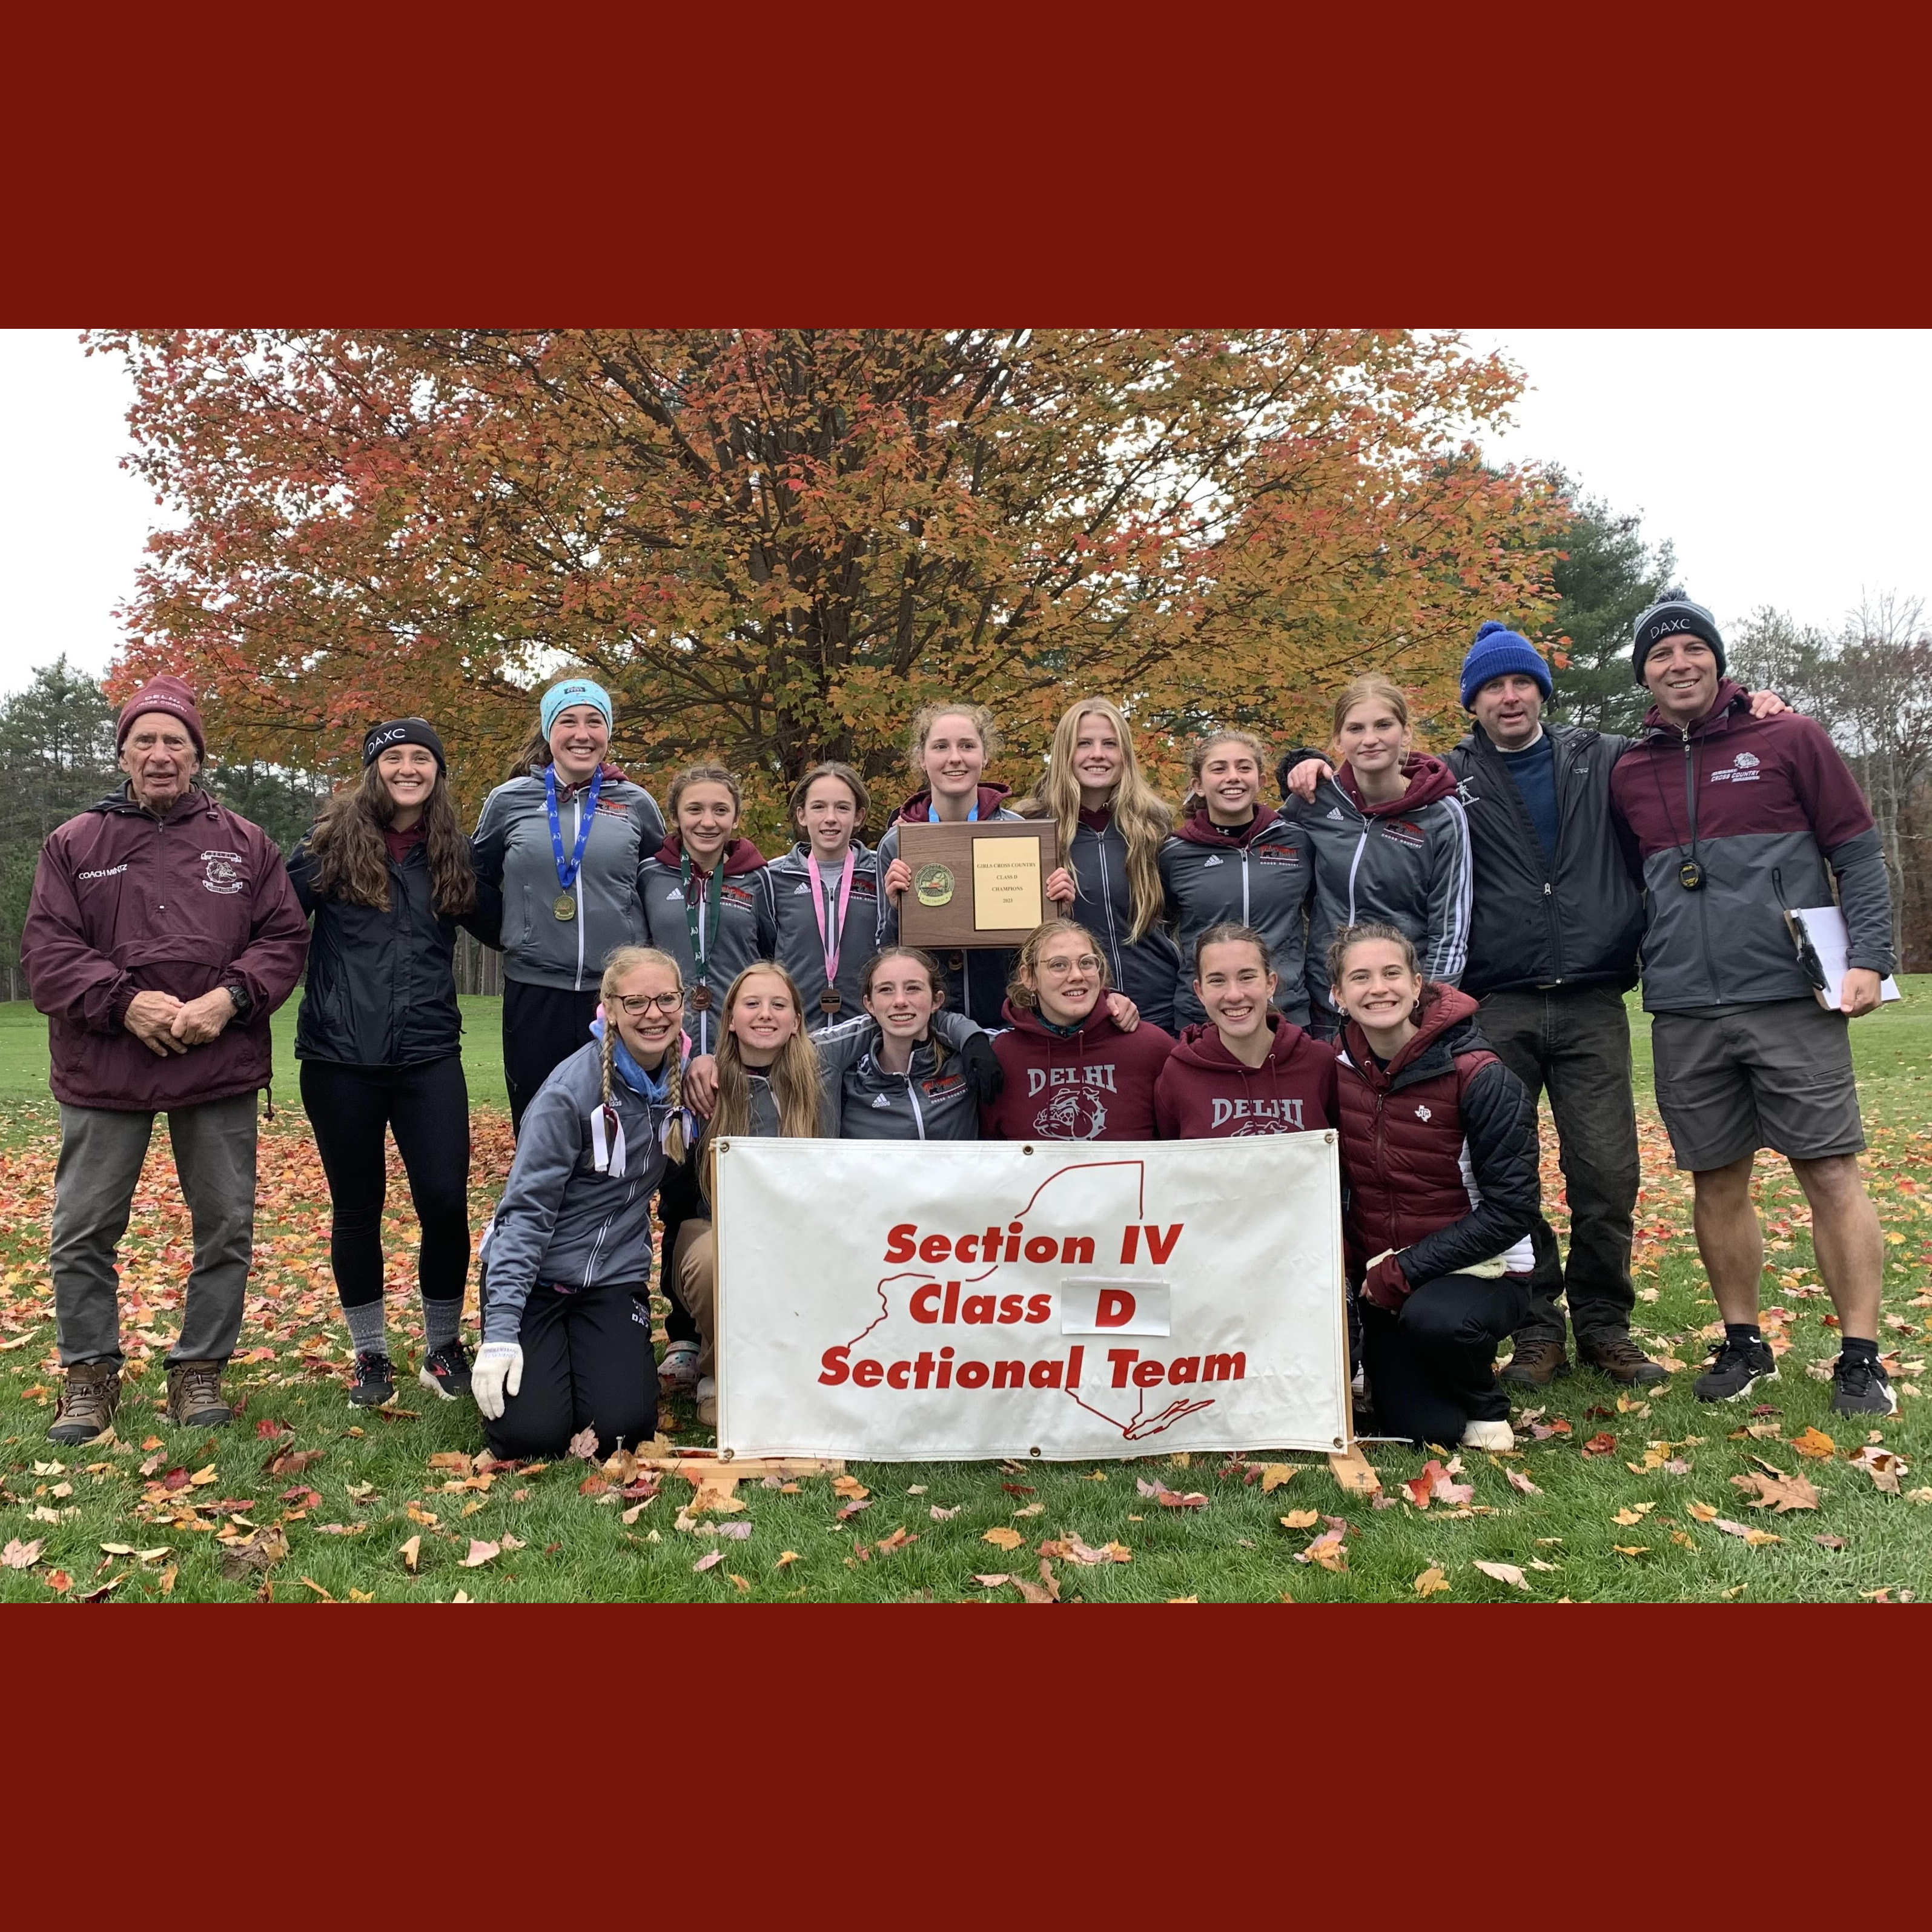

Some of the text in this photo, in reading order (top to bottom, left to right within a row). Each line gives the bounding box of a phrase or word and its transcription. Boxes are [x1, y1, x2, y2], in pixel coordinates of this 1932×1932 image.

[1650, 618, 1690, 639] DAXC
[368, 728, 405, 755] DAXC
[1711, 773, 1731, 782] CROSS
[1731, 770, 1760, 778] COUNTRY
[79, 864, 128, 880] COACH MINTZ
[1204, 859, 1224, 867] adidas
[1028, 1064, 1117, 1098] DELHI
[1212, 1098, 1305, 1131] DELHI
[884, 1222, 1183, 1265] Section IV
[909, 1281, 1136, 1327] Class D
[818, 1346, 1246, 1389] Sectional Team
